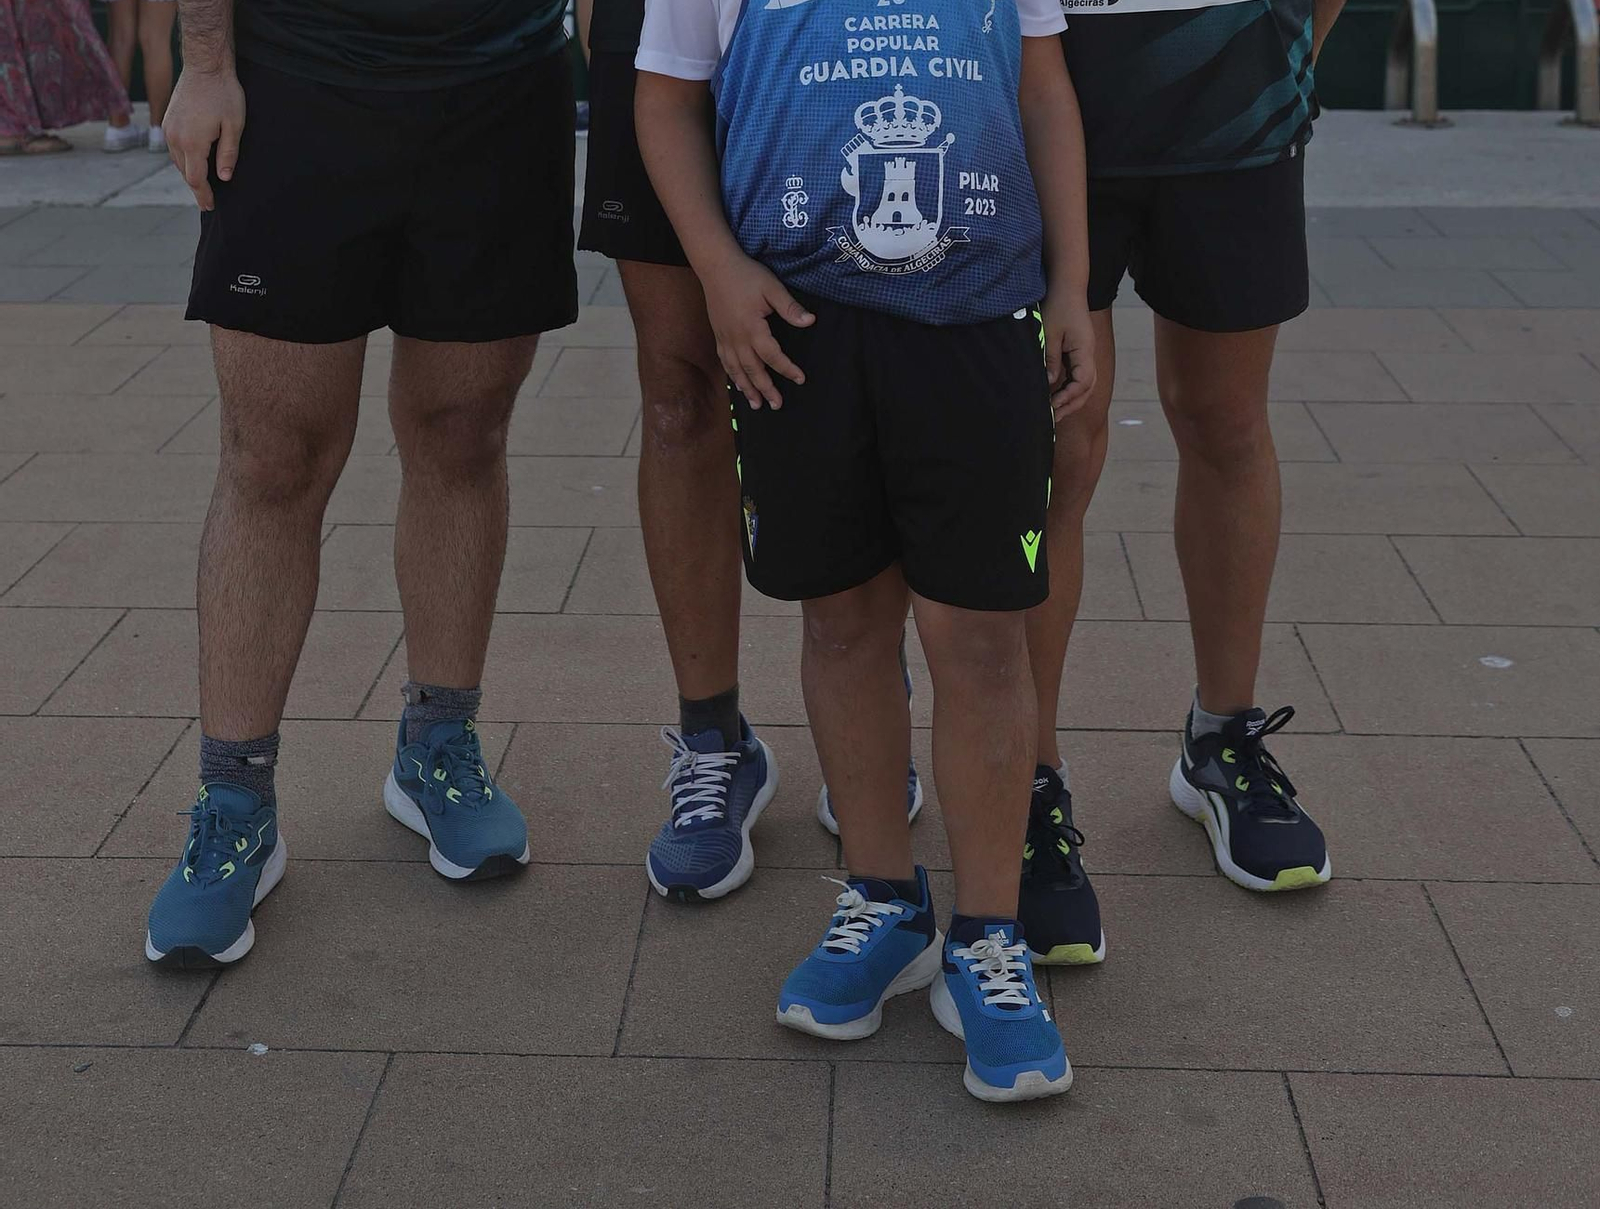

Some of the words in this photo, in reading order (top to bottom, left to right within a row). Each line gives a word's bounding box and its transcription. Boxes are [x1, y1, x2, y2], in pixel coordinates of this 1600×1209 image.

[844, 13, 940, 32] CARRERA
[847, 35, 940, 53] POPULAR
[800, 56, 918, 85] GUARDIA
[928, 57, 983, 82] CIVIL
[959, 171, 999, 192] PILAR
[964, 197, 997, 216] 2023
[903, 236, 952, 271] ALGECIRAS
